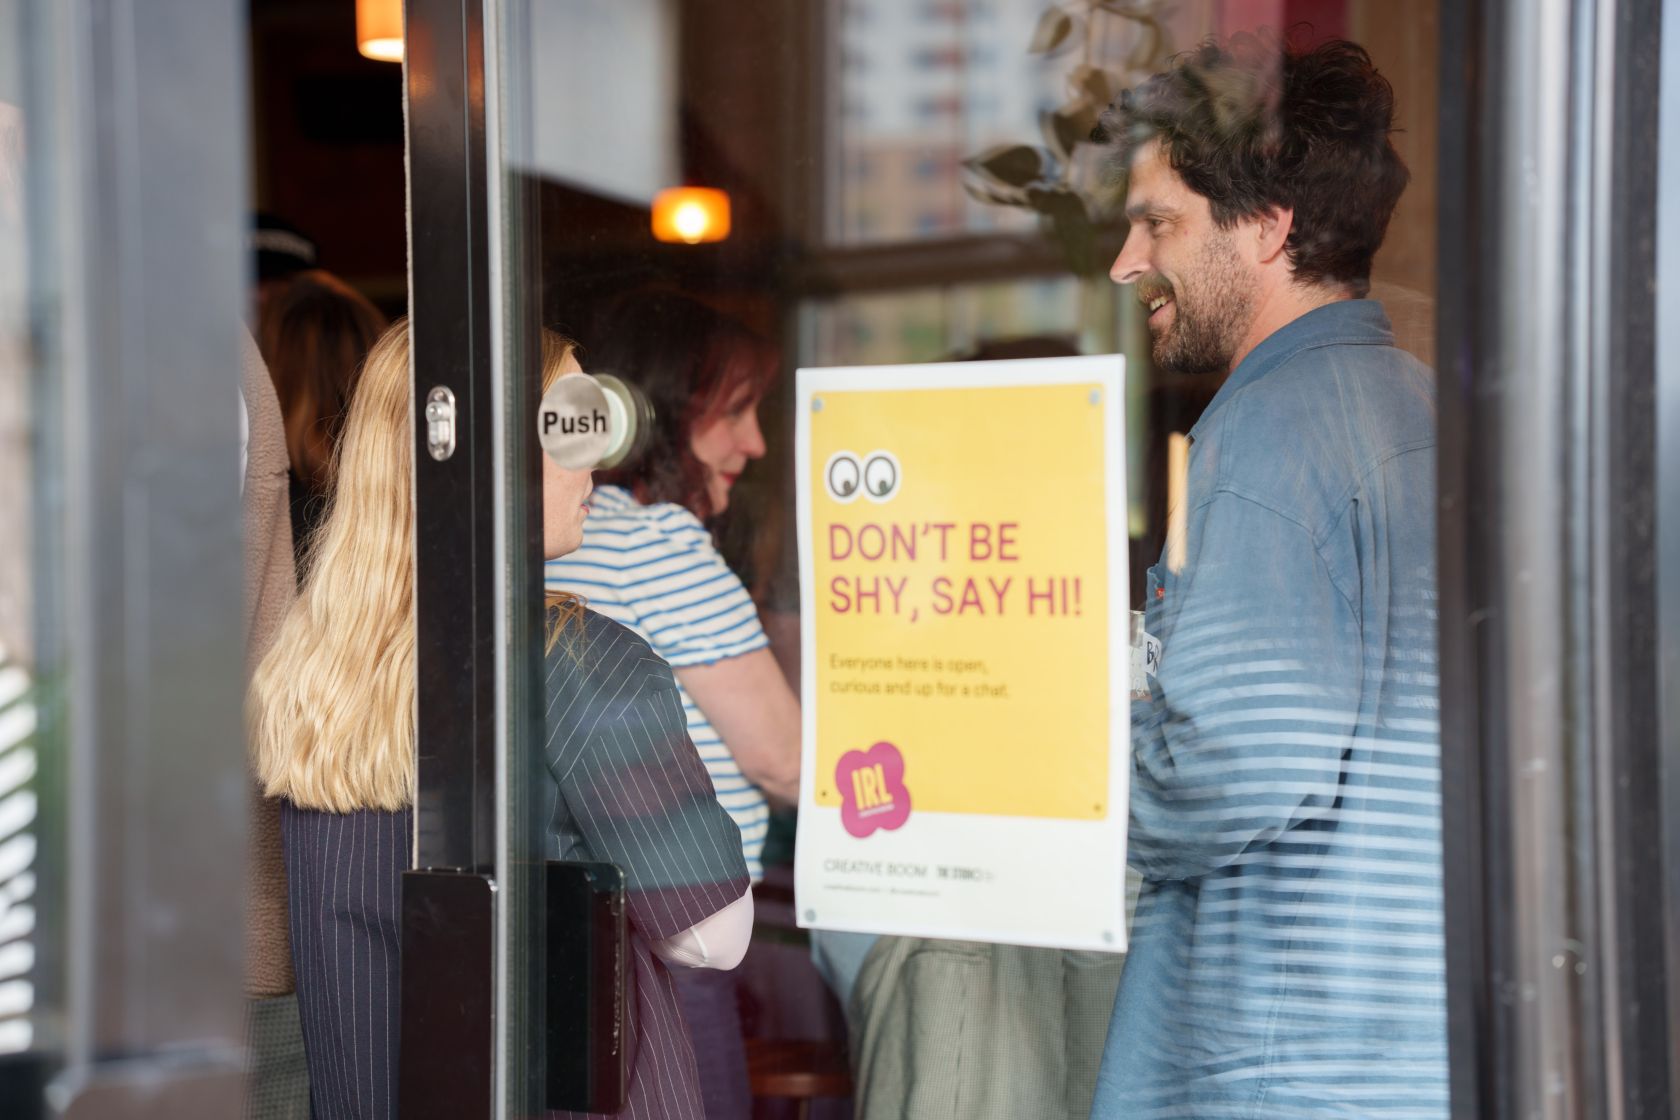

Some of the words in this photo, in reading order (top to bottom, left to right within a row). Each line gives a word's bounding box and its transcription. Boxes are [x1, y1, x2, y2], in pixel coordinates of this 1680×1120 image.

[543, 408, 607, 435] Push
[828, 522, 957, 562] DON'T
[969, 522, 1020, 562] BE
[829, 575, 918, 623] SHY,
[931, 576, 1013, 617] SAY
[1027, 576, 1083, 617] HI!
[829, 653, 894, 673] Everyone
[896, 655, 929, 671] here
[932, 655, 943, 671] is
[829, 678, 881, 694] curious
[885, 680, 912, 696] and
[915, 684, 933, 698] up
[936, 681, 958, 696] for
[960, 686, 970, 697] a
[851, 762, 894, 811] IRL
[823, 859, 883, 876] CREATIVE
[886, 862, 928, 878] BOOM
